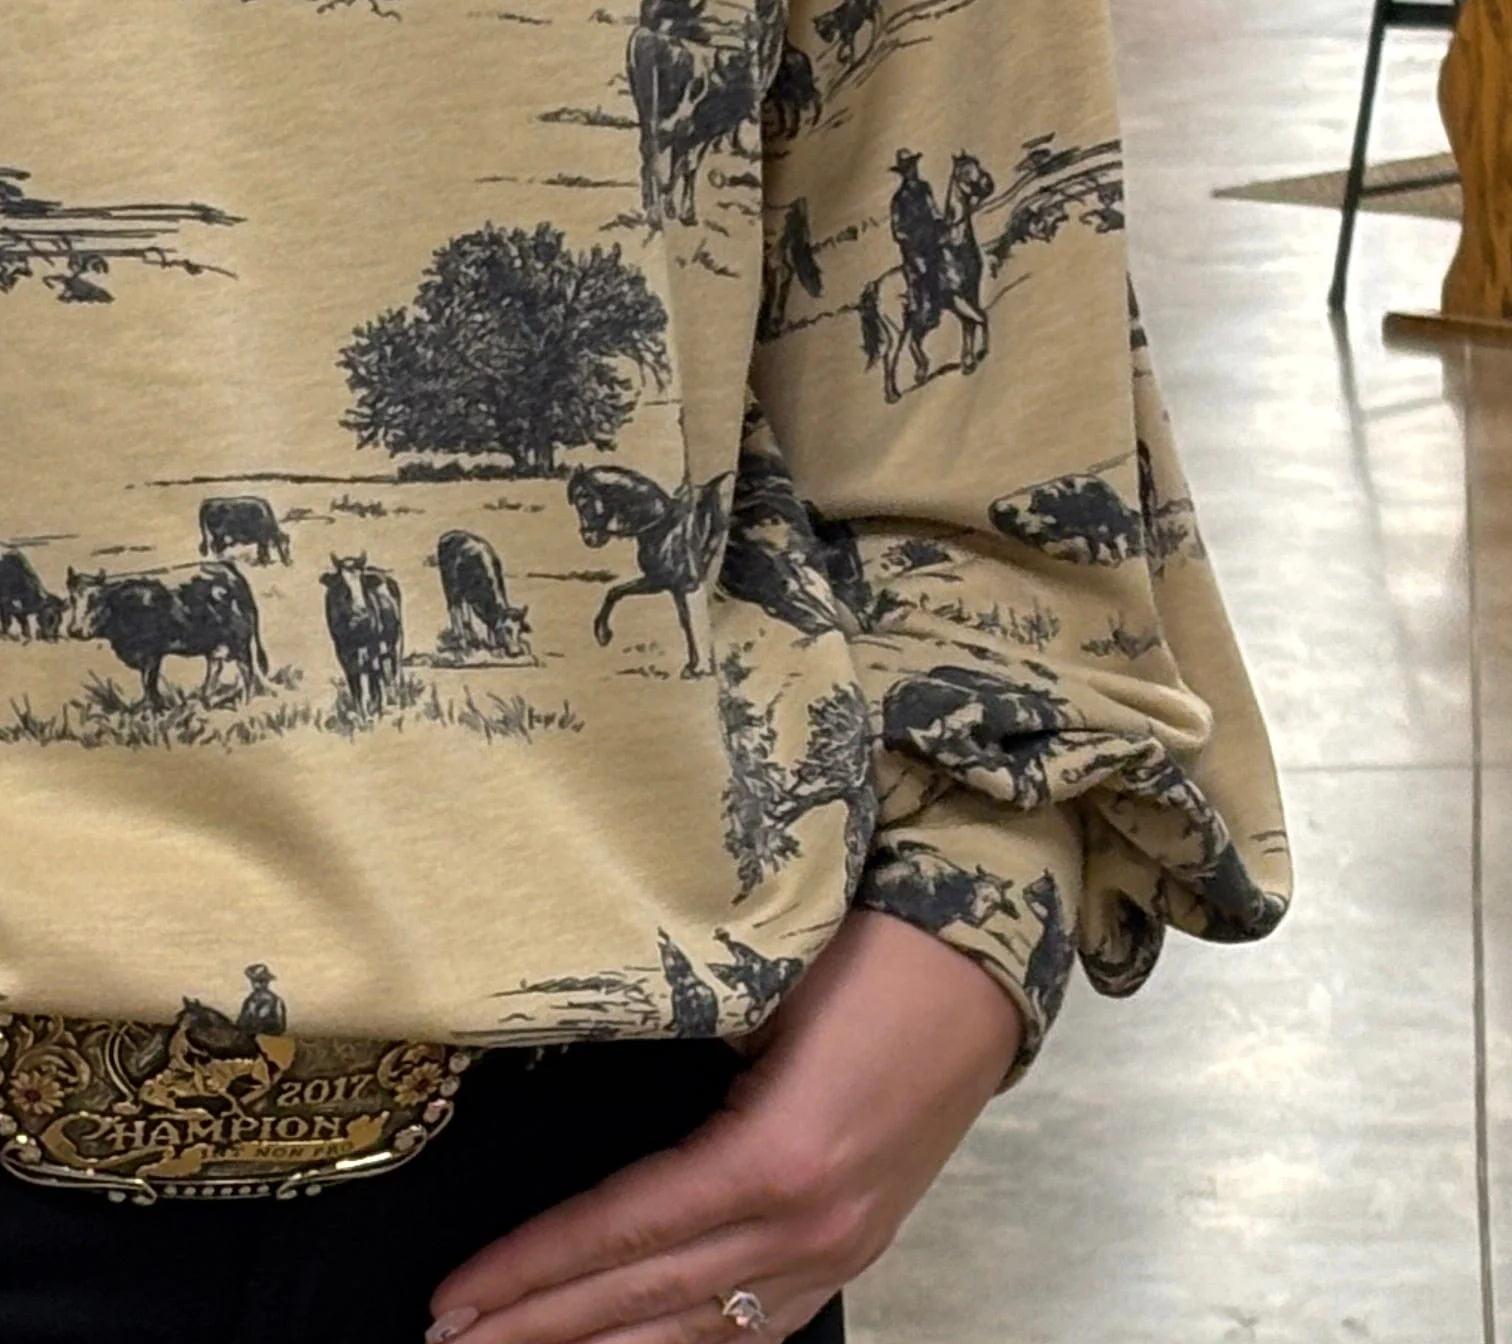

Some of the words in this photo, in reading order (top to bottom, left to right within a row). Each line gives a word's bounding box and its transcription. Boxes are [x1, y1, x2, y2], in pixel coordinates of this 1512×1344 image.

[276, 1073, 374, 1107] 2017
[41, 1111, 343, 1169] CHAMPION
[256, 1146, 303, 1158] NON
